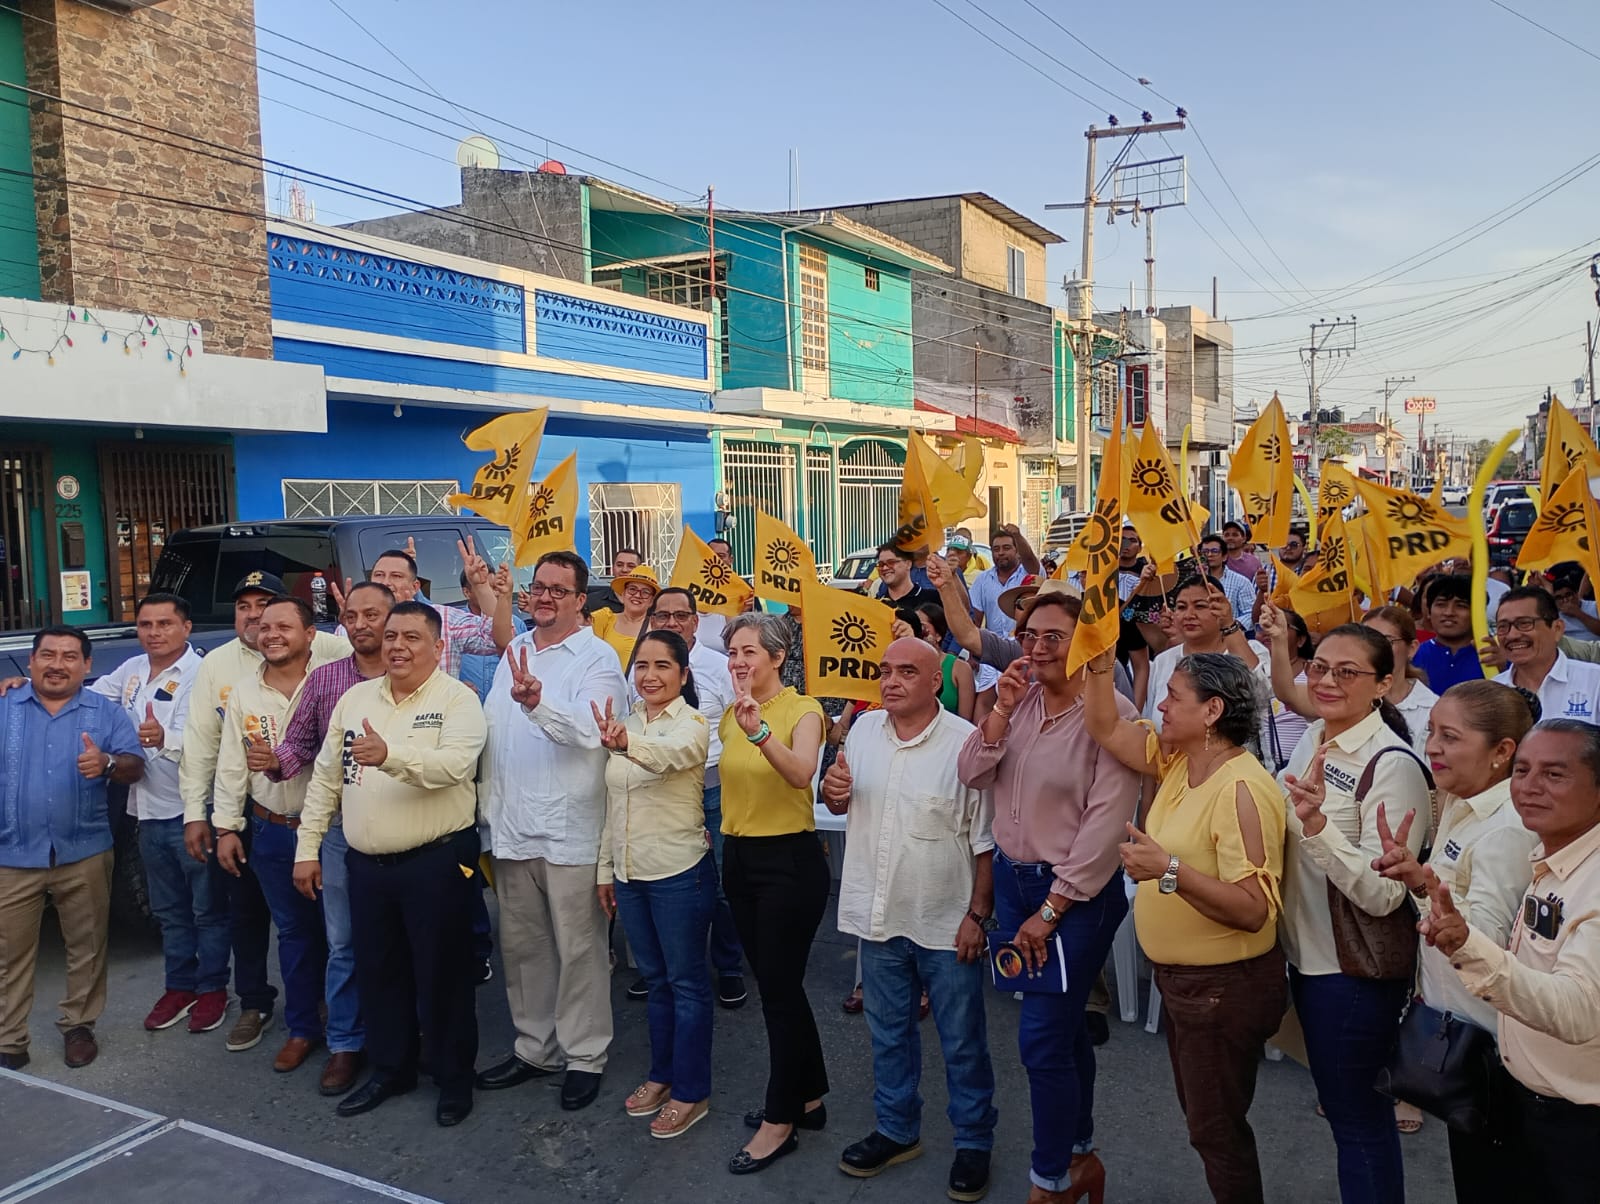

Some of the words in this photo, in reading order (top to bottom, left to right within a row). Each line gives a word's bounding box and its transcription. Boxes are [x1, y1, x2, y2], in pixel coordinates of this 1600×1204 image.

[55, 503, 82, 519] 225
[1388, 530, 1450, 560] PRD
[687, 583, 728, 606] PRD
[819, 656, 882, 681] PRD
[415, 713, 443, 721] RAFAEL
[1325, 763, 1356, 786] CARLOTA
